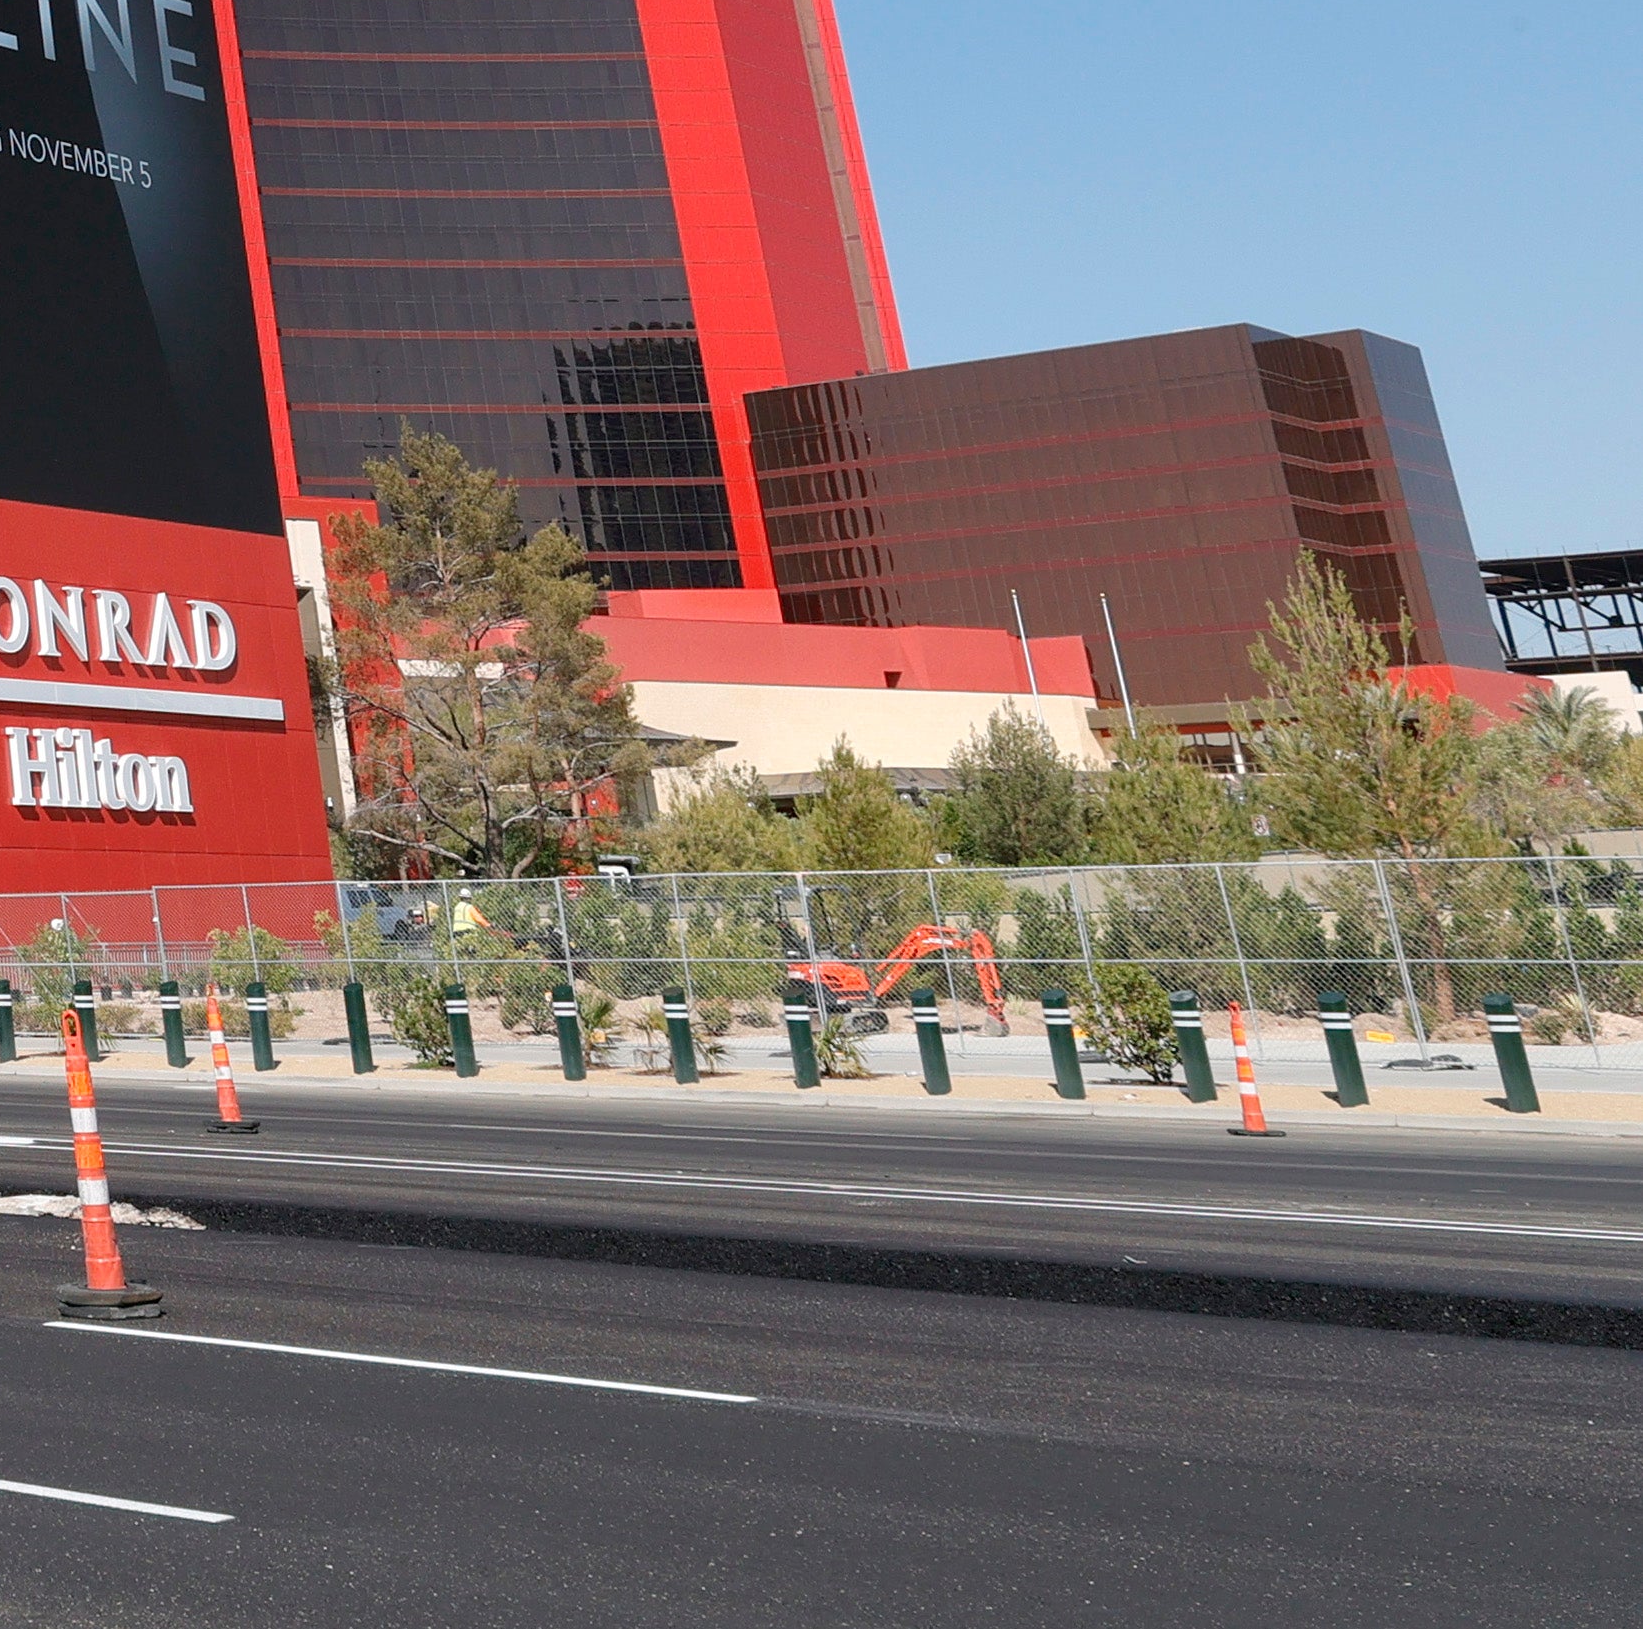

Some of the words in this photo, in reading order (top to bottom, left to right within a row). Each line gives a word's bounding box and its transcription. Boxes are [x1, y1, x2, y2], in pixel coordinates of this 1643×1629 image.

[9, 128, 135, 185] NOVEMBER
[139, 161, 153, 188] 5
[5, 726, 195, 815] Hilton
